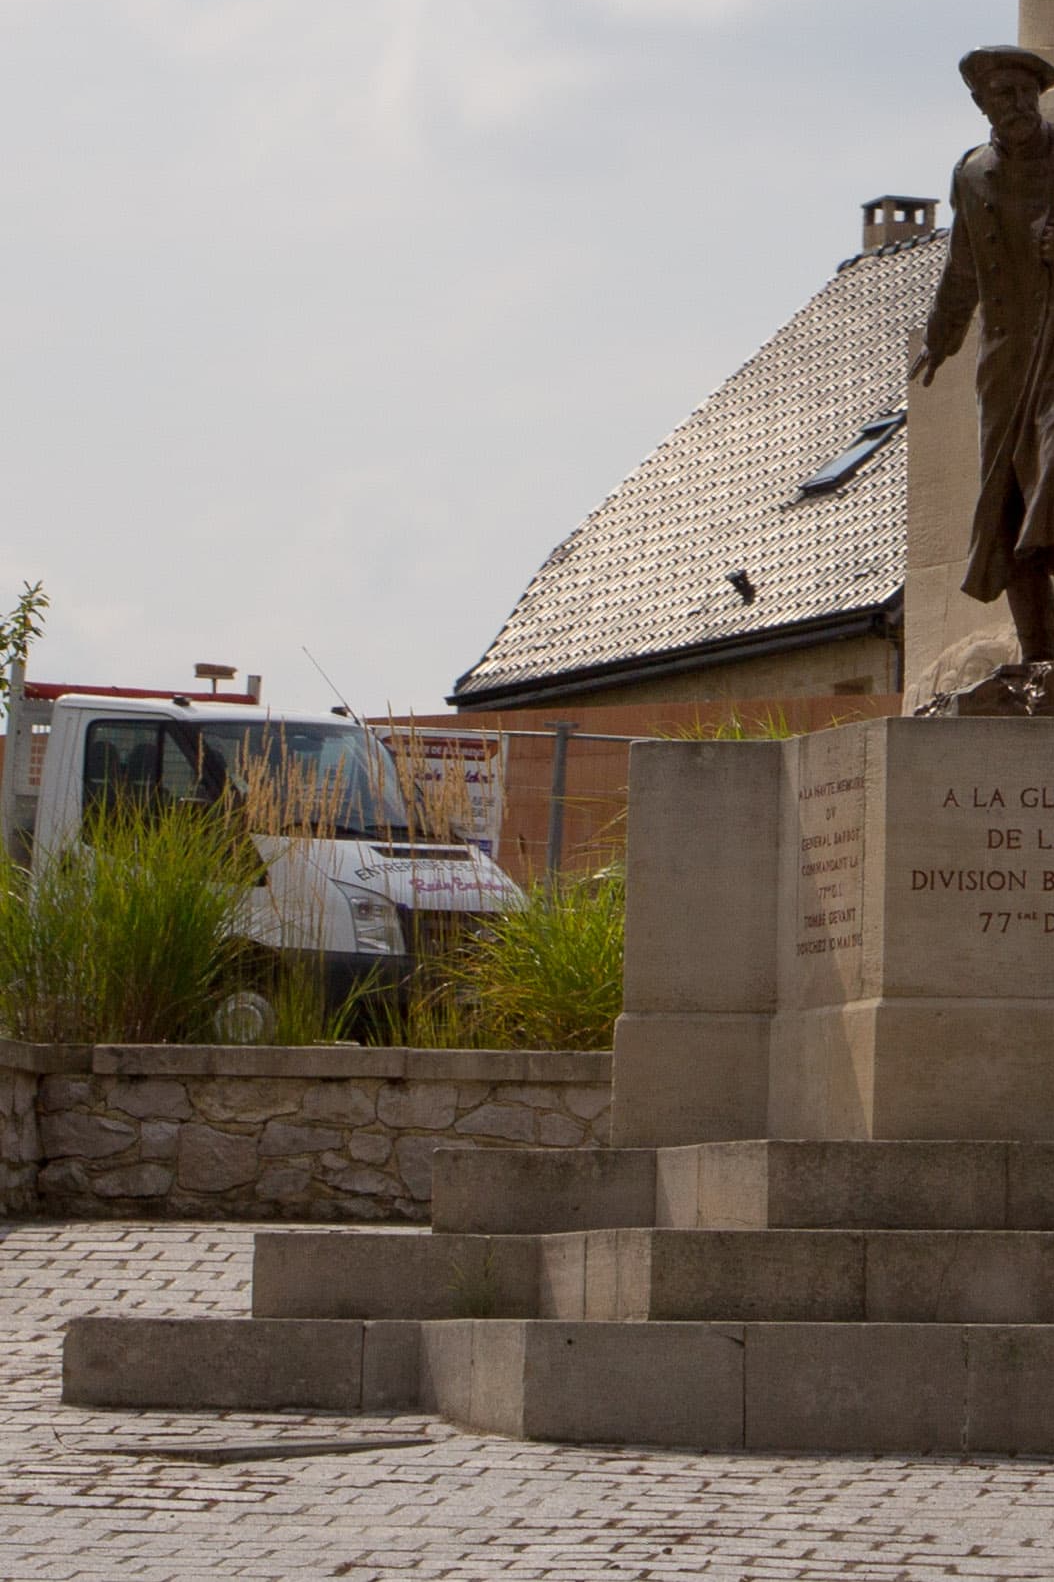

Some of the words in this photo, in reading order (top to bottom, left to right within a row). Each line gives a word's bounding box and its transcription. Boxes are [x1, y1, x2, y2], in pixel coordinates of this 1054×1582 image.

[942, 788, 960, 809] A
[973, 787, 1005, 808] LA
[987, 829, 1022, 849] DE
[911, 870, 1026, 891] DIVISION
